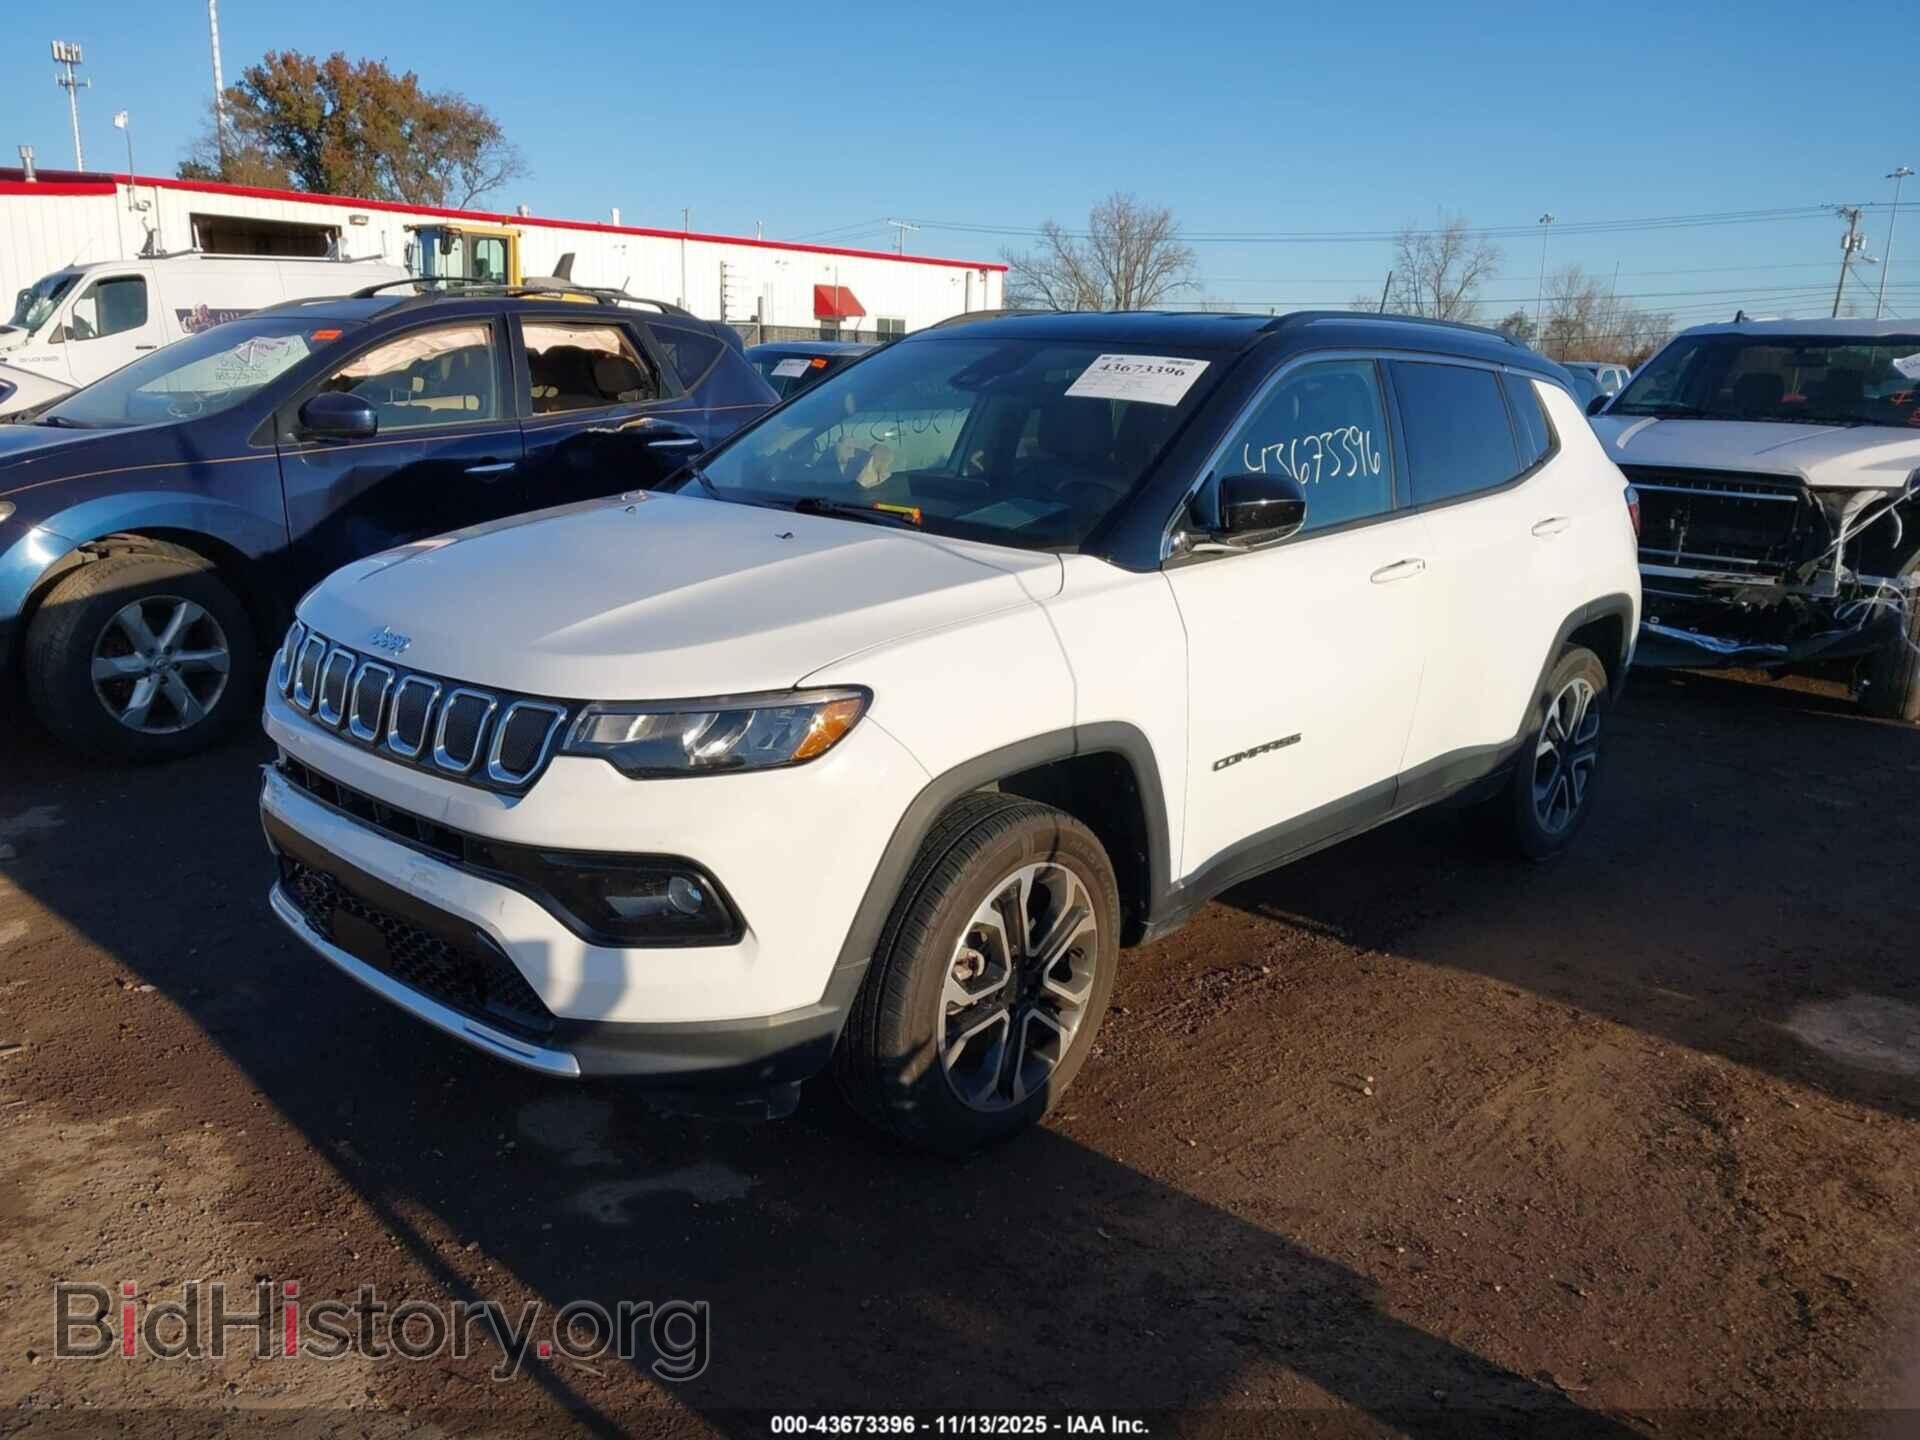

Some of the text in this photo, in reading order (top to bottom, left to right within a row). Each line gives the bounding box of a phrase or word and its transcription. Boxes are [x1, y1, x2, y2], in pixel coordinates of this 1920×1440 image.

[1099, 361, 1186, 378] 43673396
[1243, 425, 1382, 485] 43673396
[1212, 732, 1302, 772] COMPASS
